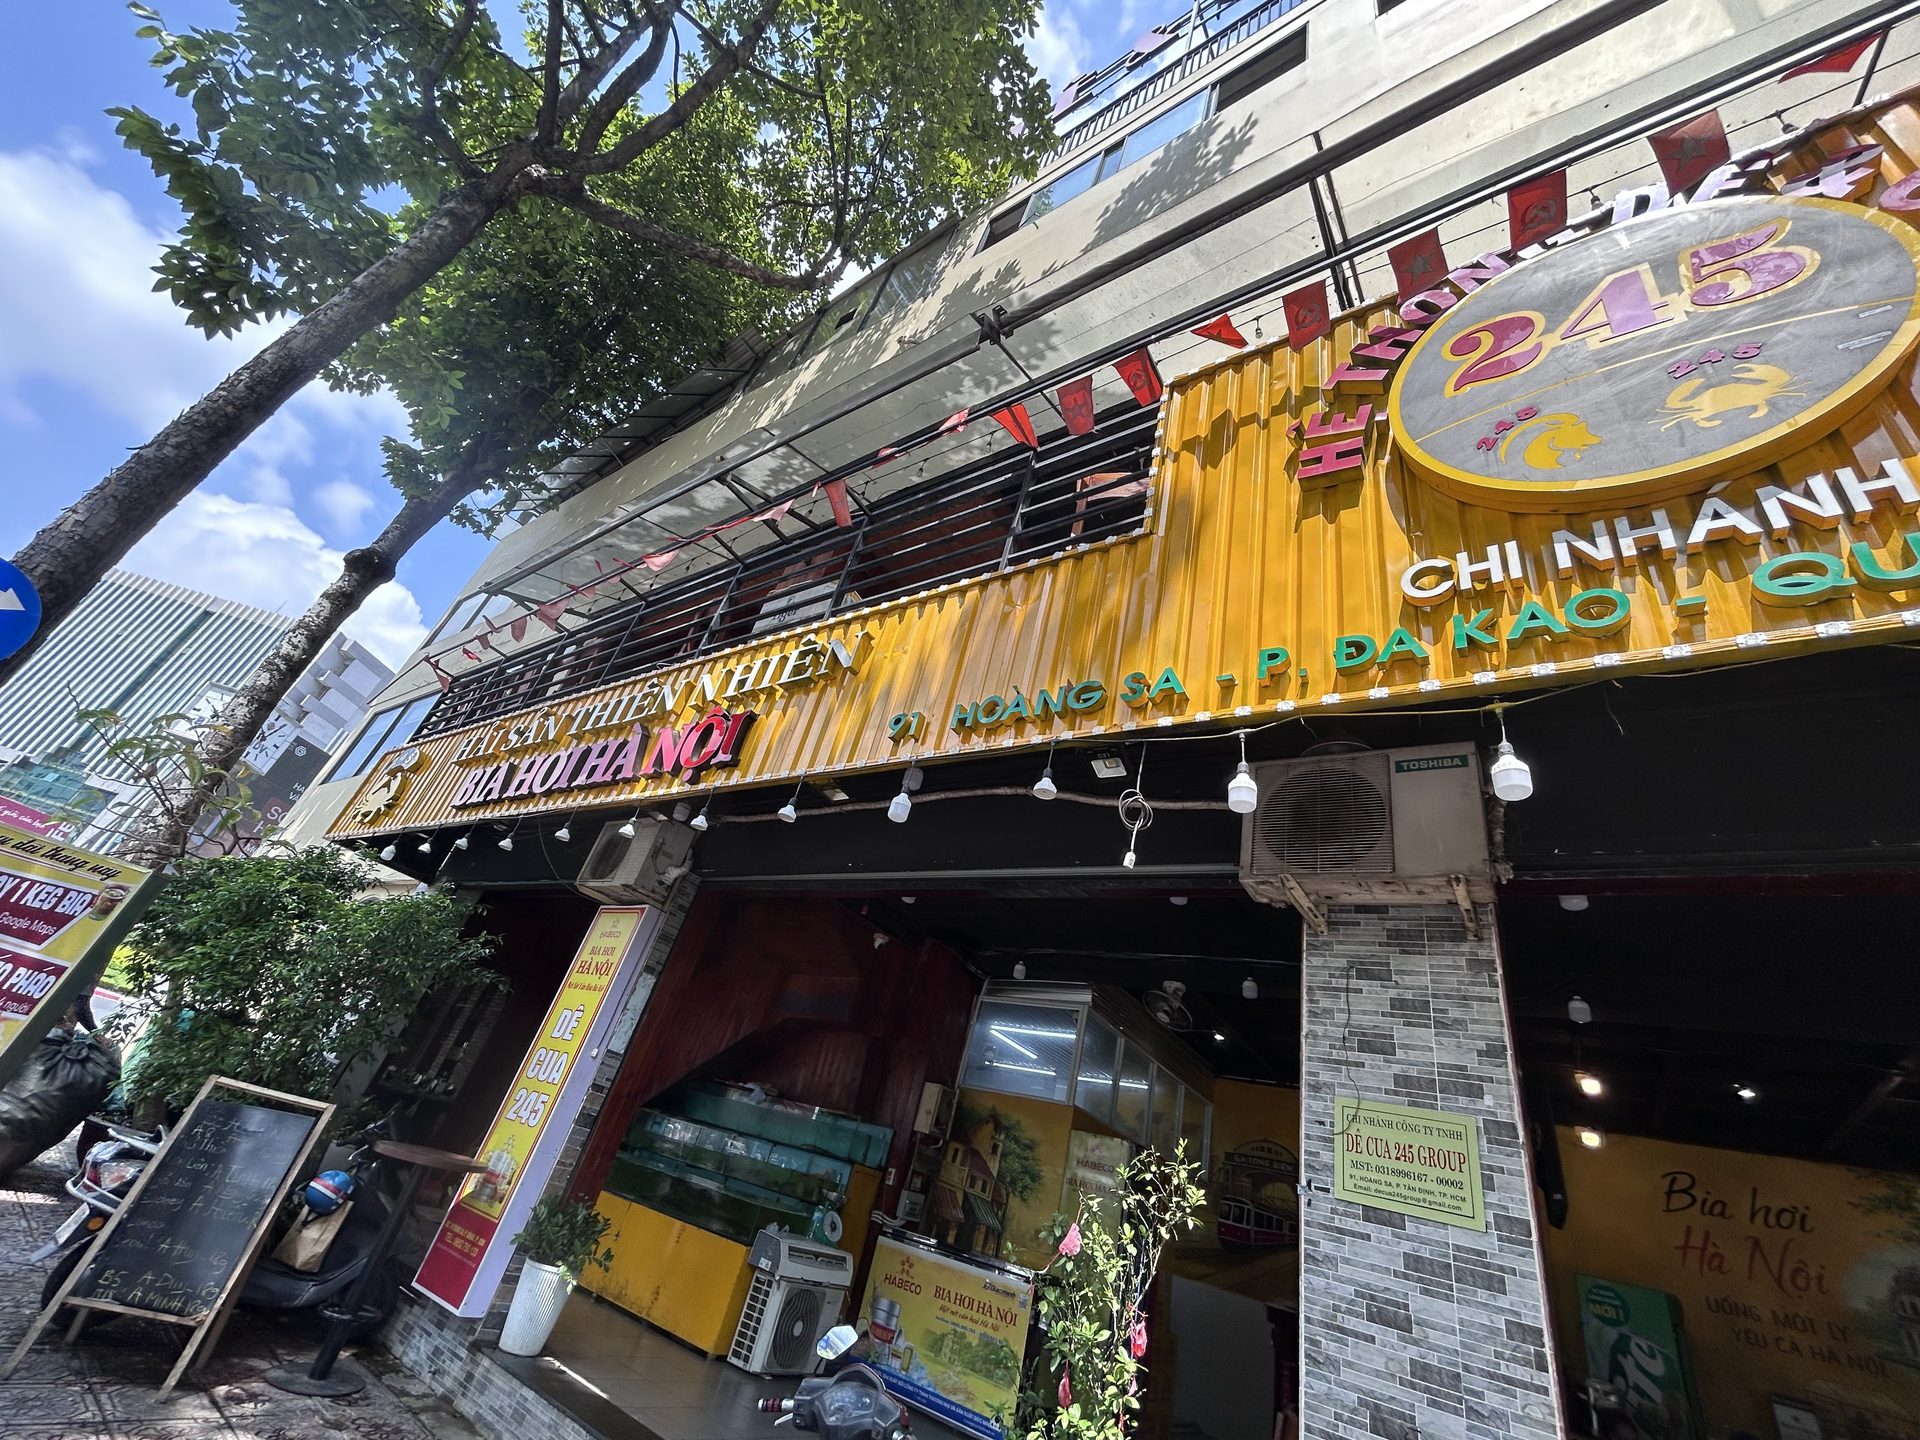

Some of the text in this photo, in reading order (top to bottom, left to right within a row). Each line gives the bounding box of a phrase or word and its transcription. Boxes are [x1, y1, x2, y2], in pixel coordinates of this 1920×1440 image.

[1446, 218, 1820, 396] 245
[1667, 342, 1763, 380] 245
[1477, 405, 1538, 451] 245
[1400, 458, 1920, 598] CHI NHÁNH
[887, 712, 922, 740] 91
[951, 680, 1104, 731] HOÀNG
[1121, 667, 1187, 701] SA
[1334, 627, 1429, 670] ĐA
[1455, 588, 1630, 656] KAO
[452, 632, 868, 763] HẢI SẢN THIÊN NHIÊN
[450, 706, 755, 807] BIA HƠI HÀ NỘI
[1400, 758, 1463, 770] TOSHIBA
[10, 880, 31, 903] 1
[20, 882, 64, 910] KEG
[55, 890, 93, 916] BIA
[29, 919, 57, 936] Maps
[575, 957, 614, 979] HÀ NỘI
[551, 1004, 585, 1041] DÊ
[526, 1046, 569, 1085] CUA
[505, 1087, 551, 1127] 245
[1346, 1113, 1463, 1141] CHI NHÁNH CÔNG TY TNHH
[1076, 1158, 1115, 1174] HABECO
[1346, 1129, 1466, 1173] DÊ CUA 245 GROUP
[1350, 1160, 1374, 1173] MST:
[1374, 1165, 1428, 1183] 0318996167
[1436, 1176, 1464, 1190] 00002
[1353, 1183, 1373, 1193] Email:
[1359, 1175, 1382, 1186] HOÀNG
[1403, 1183, 1416, 1193] TÂN
[1450, 1194, 1467, 1203] HCM
[1661, 1171, 1815, 1233] Bia hơi
[1673, 1224, 1830, 1301] Hà Nội
[884, 1272, 922, 1296] HABECO
[933, 1285, 952, 1304] BIA
[953, 1292, 976, 1311] HƠI
[976, 1300, 993, 1318] HÀ
[995, 1306, 1018, 1328] NỘI
